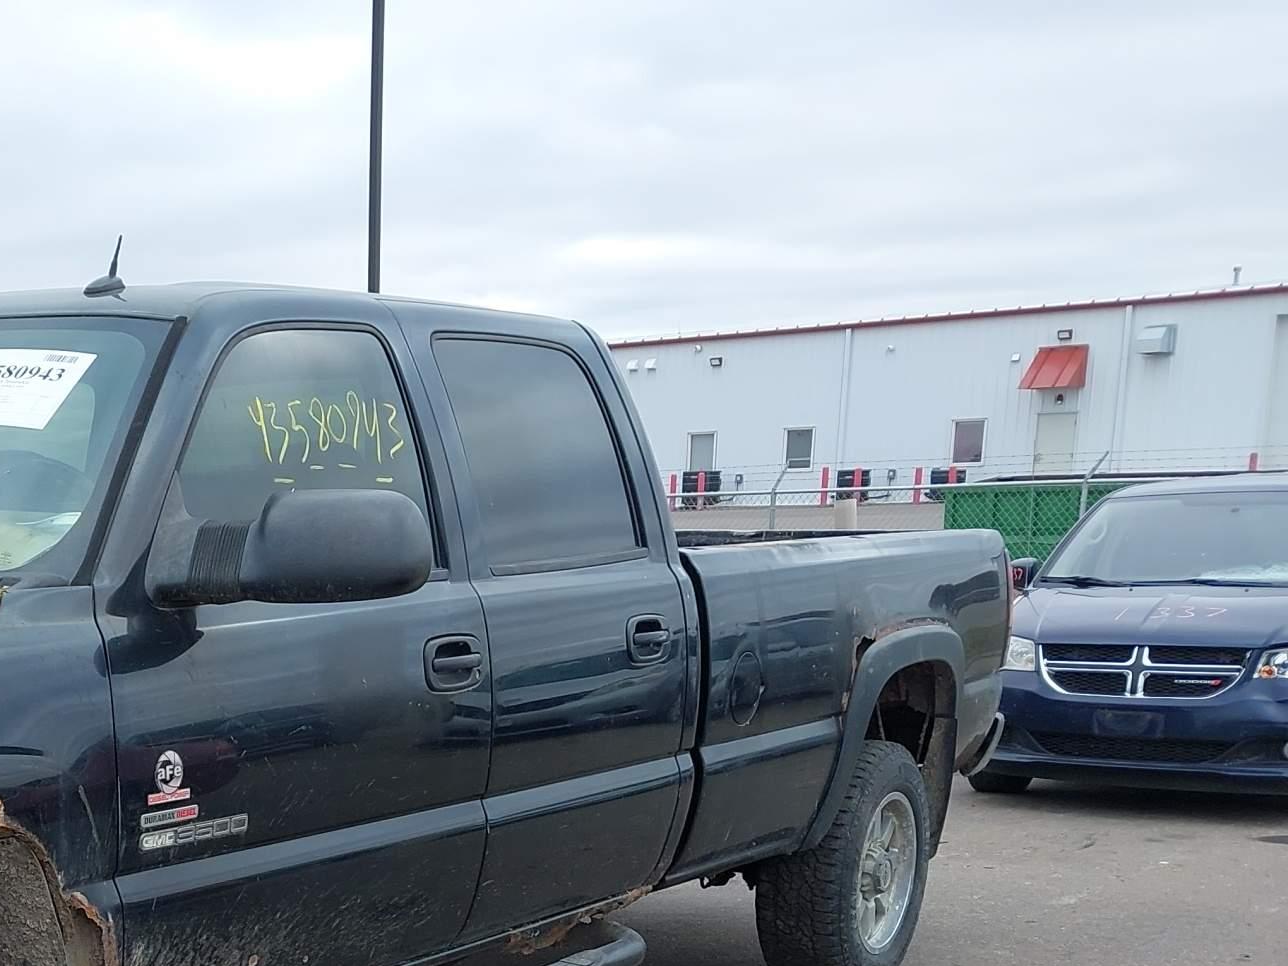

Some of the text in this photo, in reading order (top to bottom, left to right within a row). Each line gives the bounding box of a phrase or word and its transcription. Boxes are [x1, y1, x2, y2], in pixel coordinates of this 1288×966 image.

[247, 390, 405, 465] 43580943
[157, 764, 182, 782] aFe
[143, 807, 197, 825] DURAMAX DIESEL
[141, 830, 176, 849] GMC
